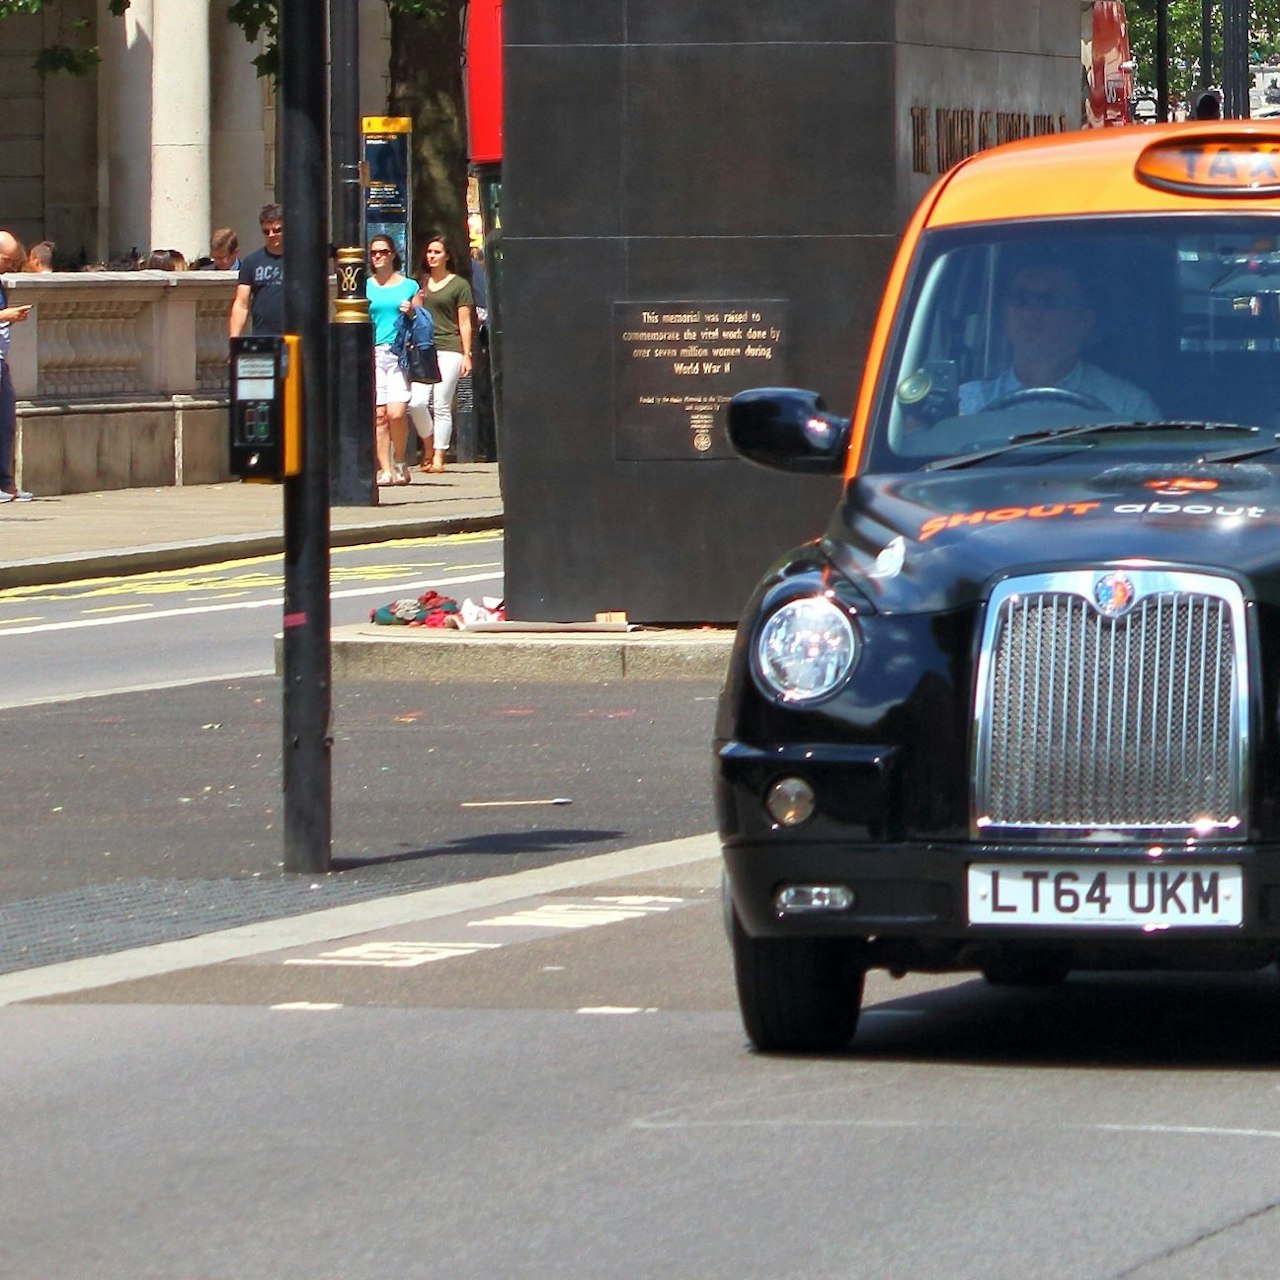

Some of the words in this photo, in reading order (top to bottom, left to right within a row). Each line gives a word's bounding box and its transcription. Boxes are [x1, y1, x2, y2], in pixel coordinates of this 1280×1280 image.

[642, 311, 659, 324] This
[662, 311, 700, 324] memorial
[705, 313, 719, 323] was
[723, 311, 748, 324] raised
[752, 312, 761, 322] to
[623, 331, 680, 342] commemorate
[683, 329, 697, 341] the
[700, 328, 719, 341] vital
[722, 328, 743, 340] work
[747, 328, 767, 340] done
[770, 327, 781, 342] by
[633, 348, 651, 358] over
[654, 348, 677, 358] seven
[680, 346, 709, 358] million
[712, 347, 741, 357] women
[745, 345, 772, 360] during
[674, 363, 700, 375] World
[703, 363, 721, 375] War
[917, 501, 1100, 542] SHOUT
[1113, 502, 1264, 519] about
[991, 870, 1111, 914] LT64
[1128, 871, 1219, 914] UKM
